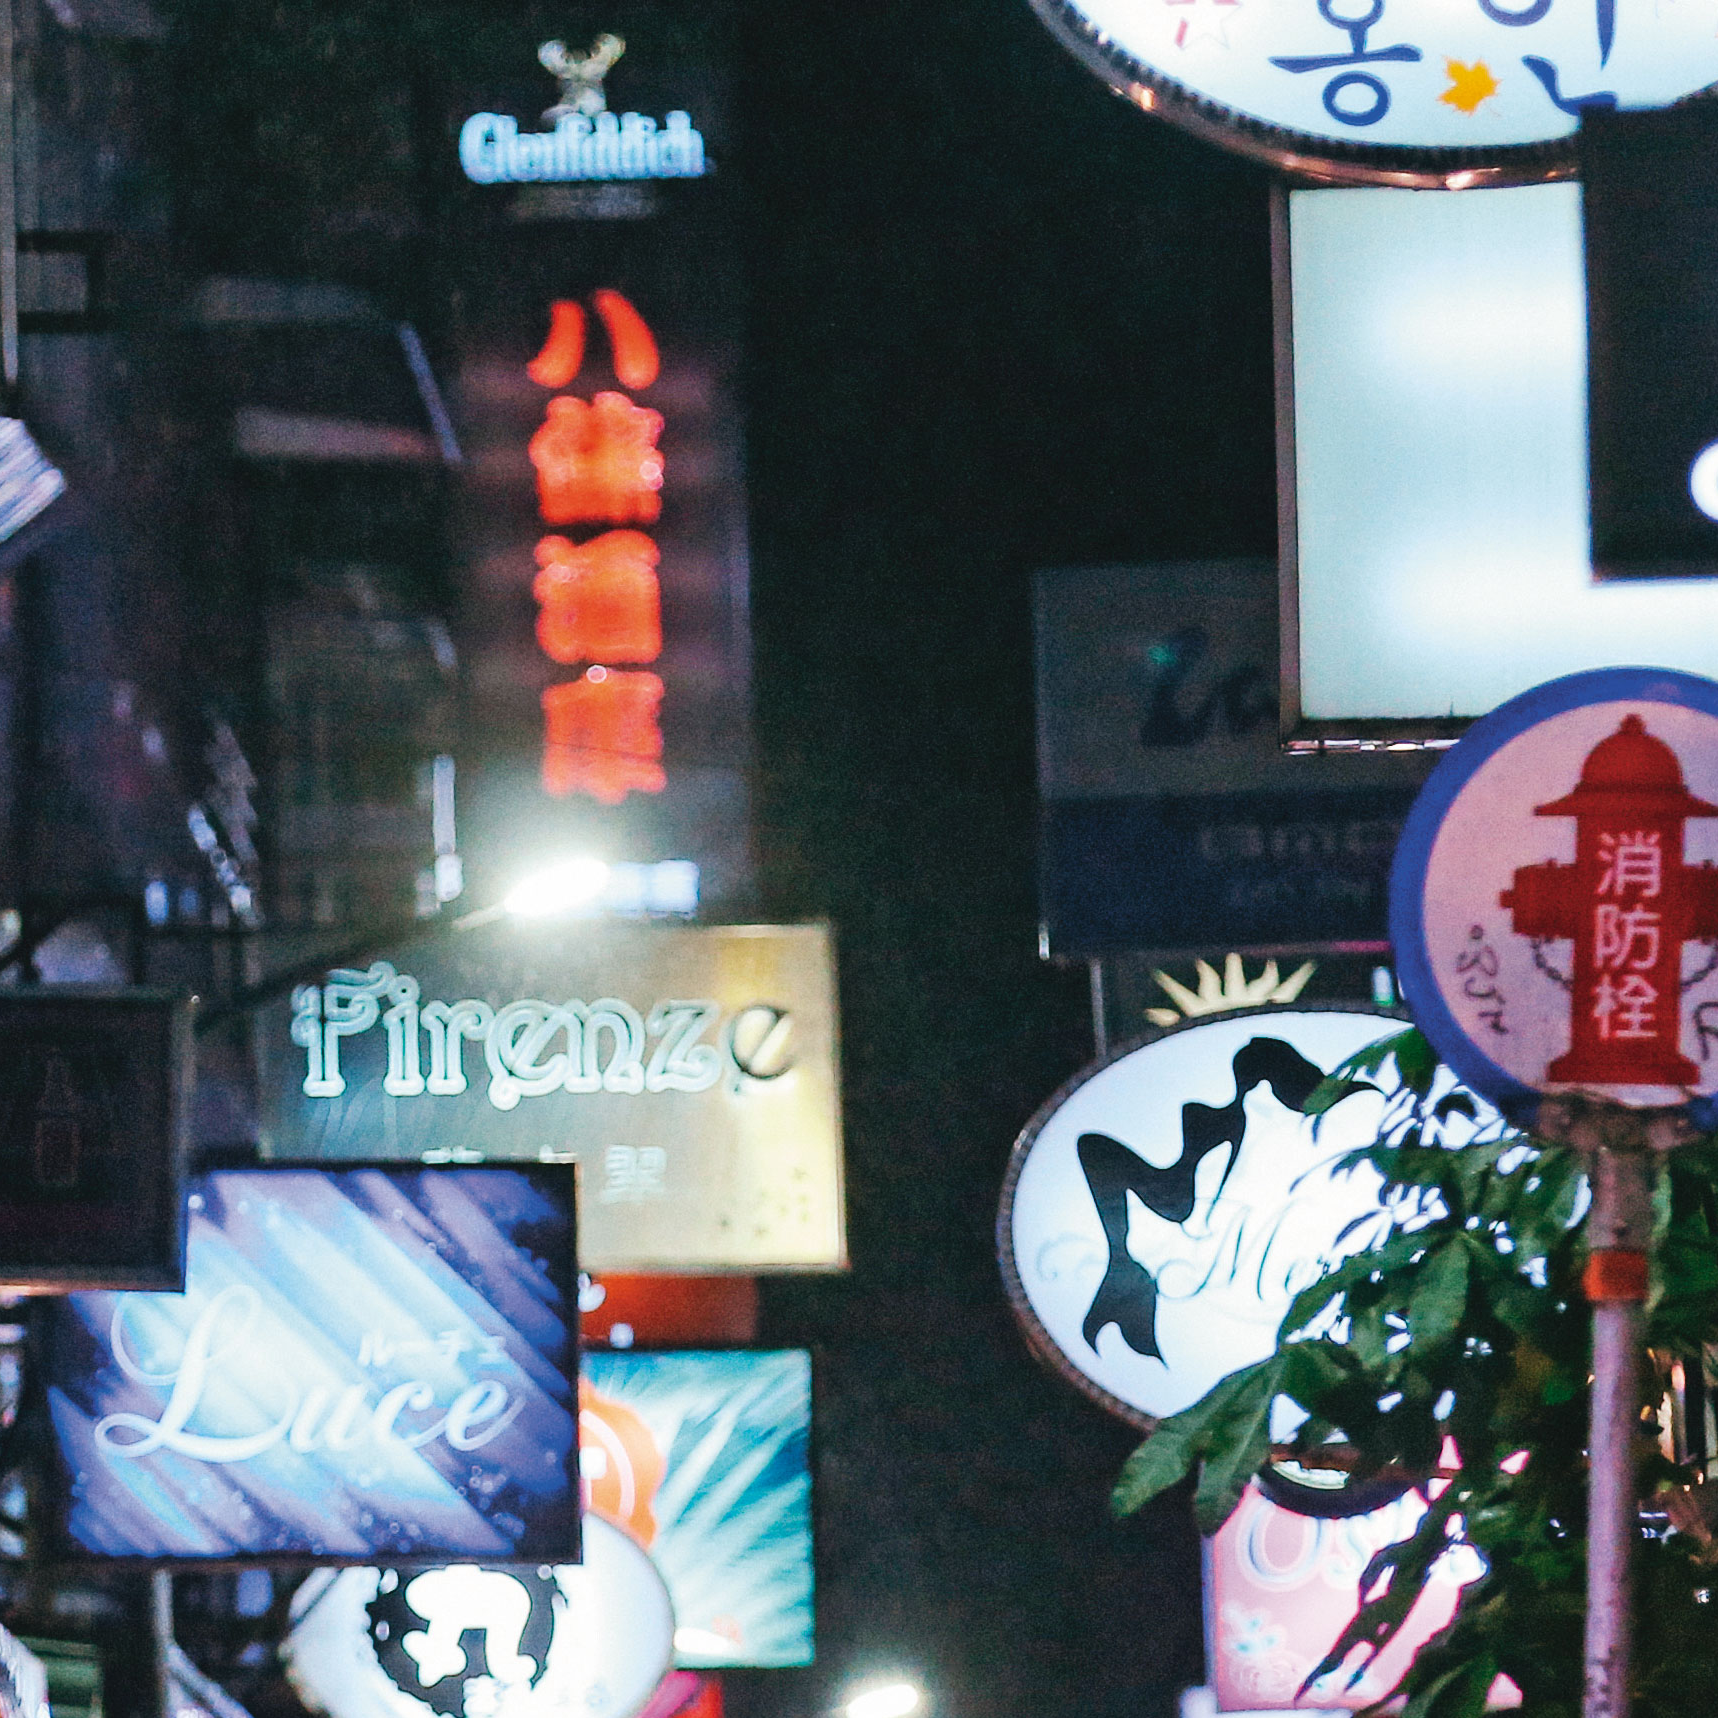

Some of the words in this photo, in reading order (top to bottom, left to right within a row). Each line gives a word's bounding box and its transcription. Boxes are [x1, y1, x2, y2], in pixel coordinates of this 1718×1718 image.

[1594, 830, 1663, 1041] 消防栓
[290, 960, 798, 1111] Firenze
[94, 1284, 527, 1463] Luce
